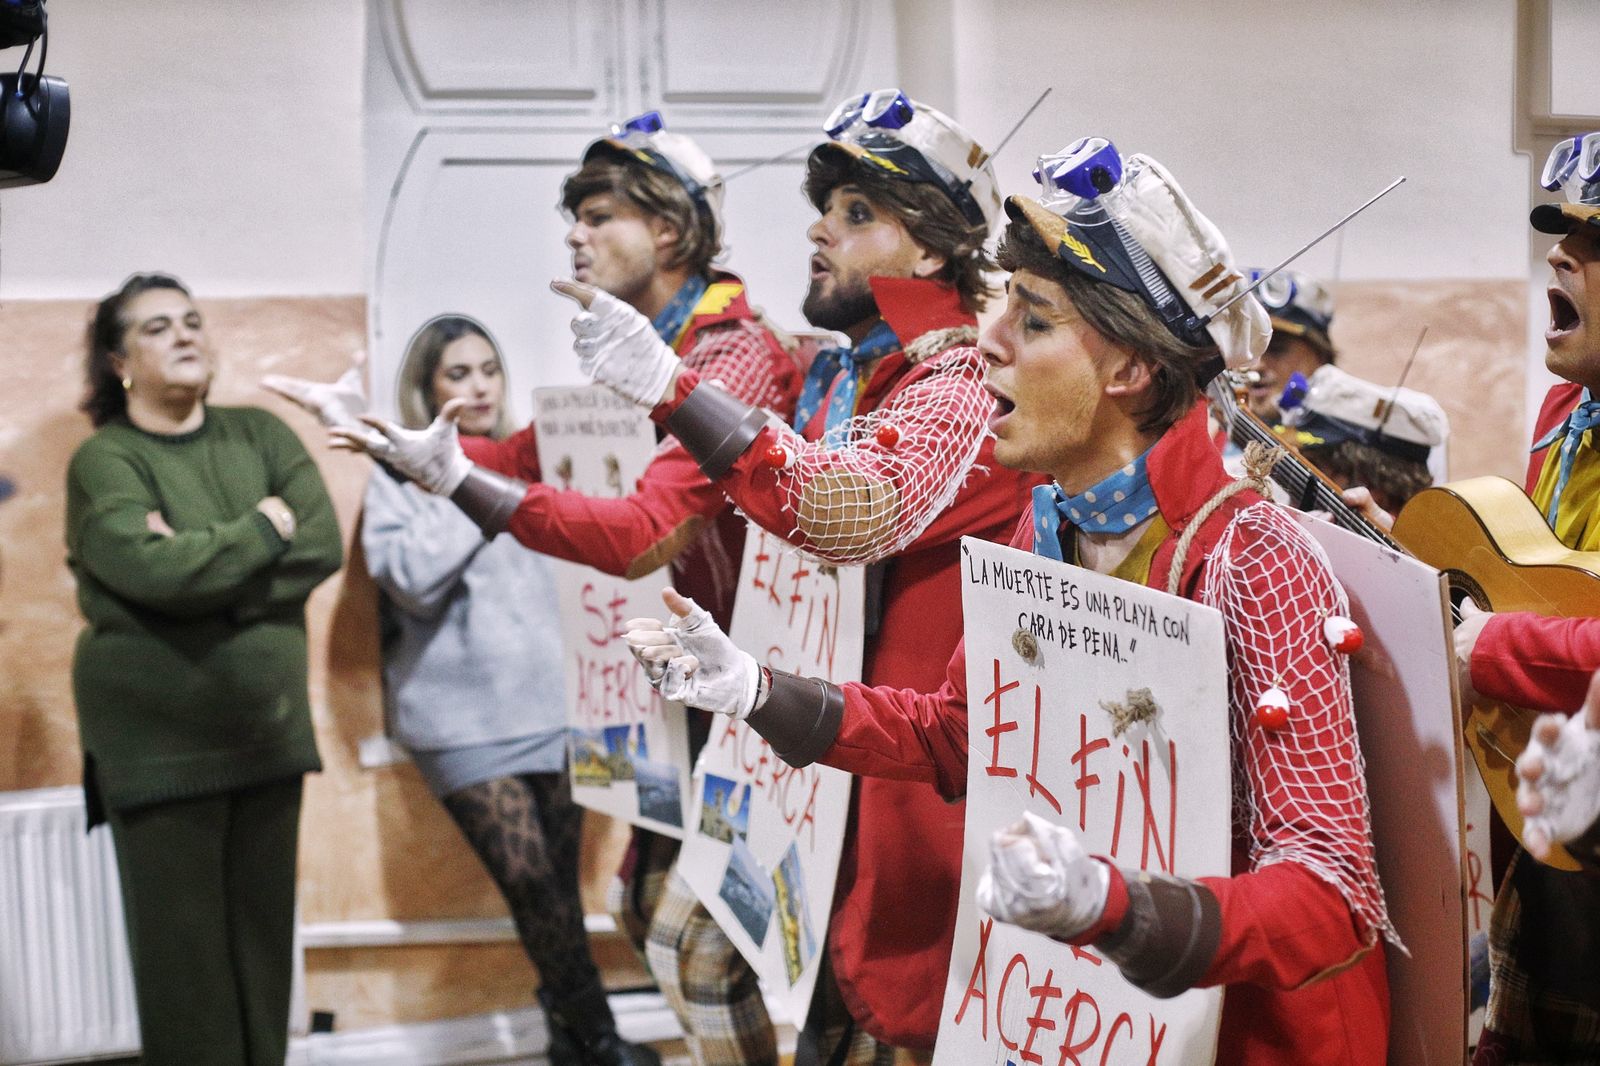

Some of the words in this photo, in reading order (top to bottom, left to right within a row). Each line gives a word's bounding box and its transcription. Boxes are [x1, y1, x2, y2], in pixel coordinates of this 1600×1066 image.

[754, 529, 782, 608] EL
[992, 560, 1055, 602] MUERTE
[1060, 578, 1080, 611] ES
[1085, 590, 1111, 620] UNA
[1113, 595, 1158, 637] PLAYA
[1163, 612, 1190, 646] CON
[581, 582, 628, 648] SE
[1017, 611, 1055, 642] CARA
[1058, 619, 1078, 649] DE
[983, 658, 1063, 816] EL
